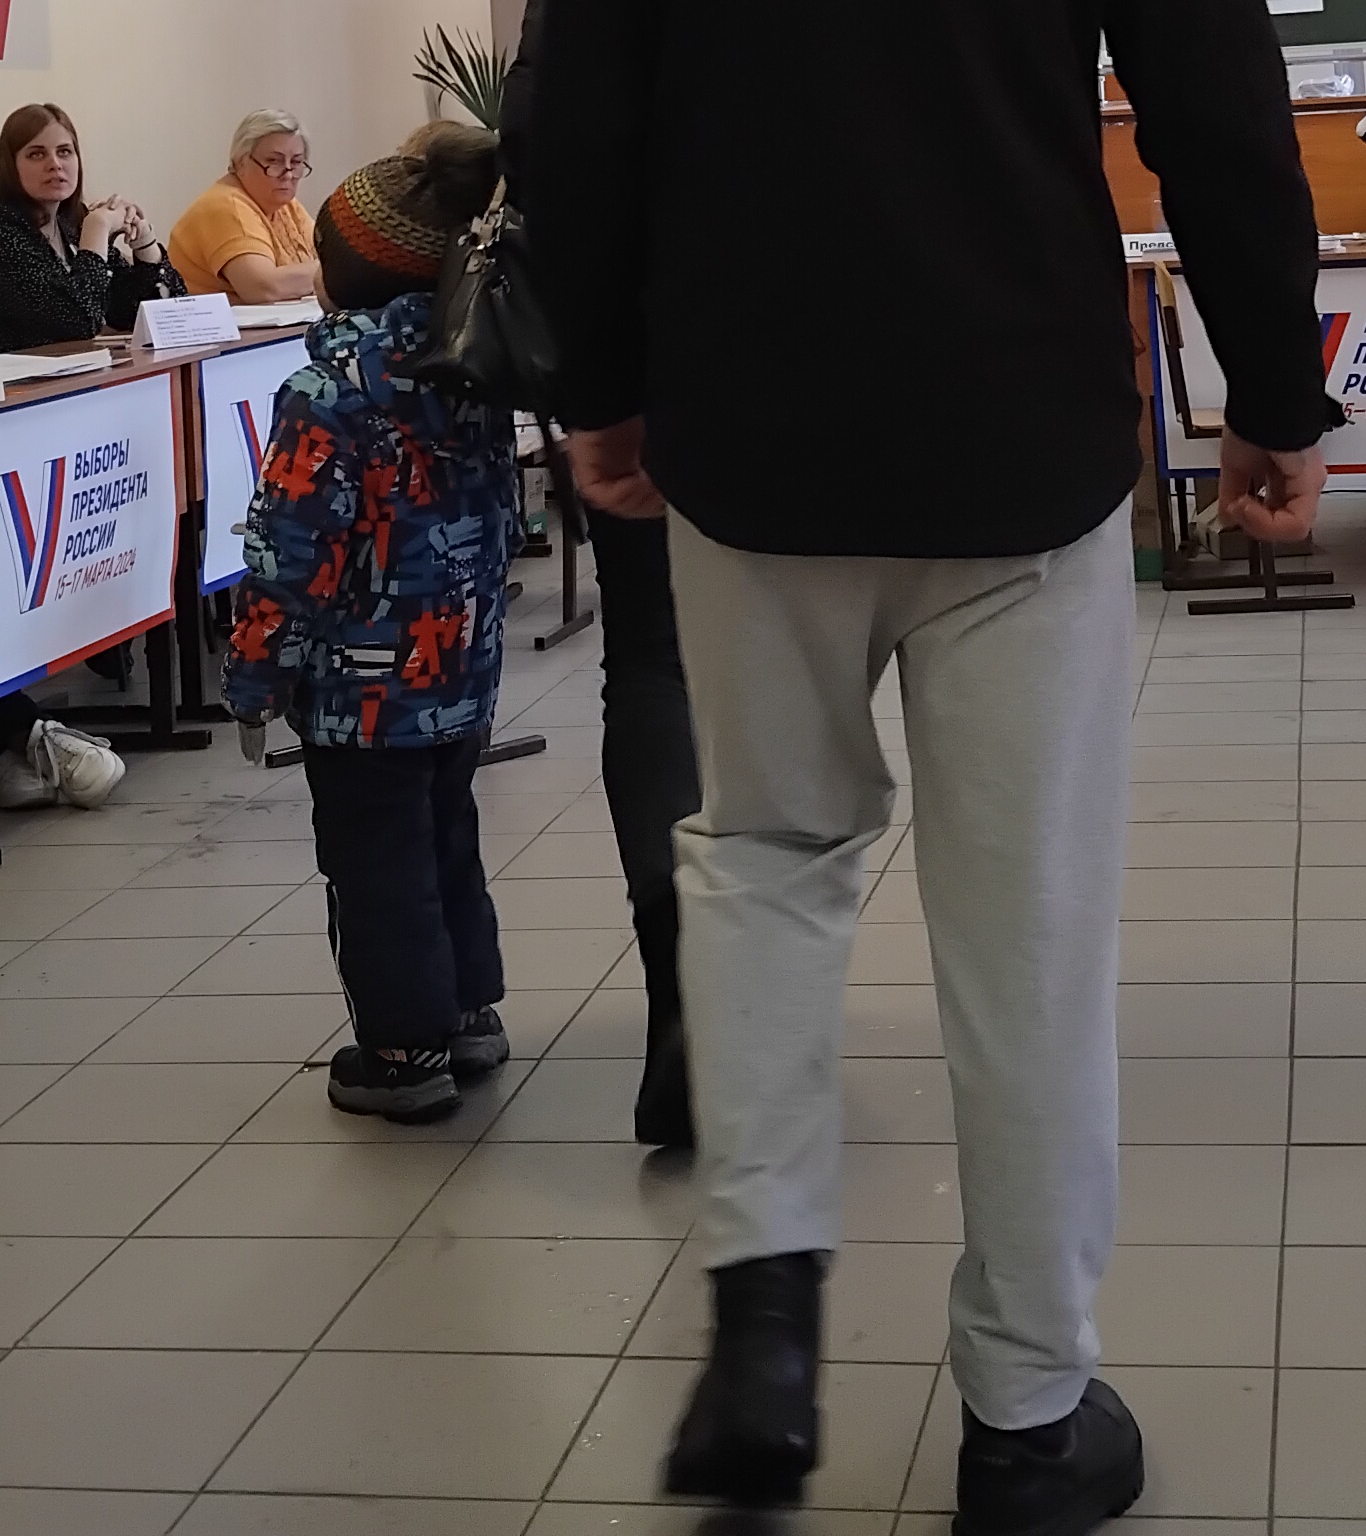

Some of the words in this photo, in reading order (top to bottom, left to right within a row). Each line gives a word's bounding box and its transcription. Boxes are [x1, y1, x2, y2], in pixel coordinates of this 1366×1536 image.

[1129, 241, 1175, 252] Предс
[74, 438, 130, 481] ВЫБОРЫ
[70, 470, 148, 523] ПРЕЗИДЕНТА
[62, 519, 117, 565] РОССИИ
[81, 556, 114, 590] МАРТА
[112, 547, 137, 577] 2024
